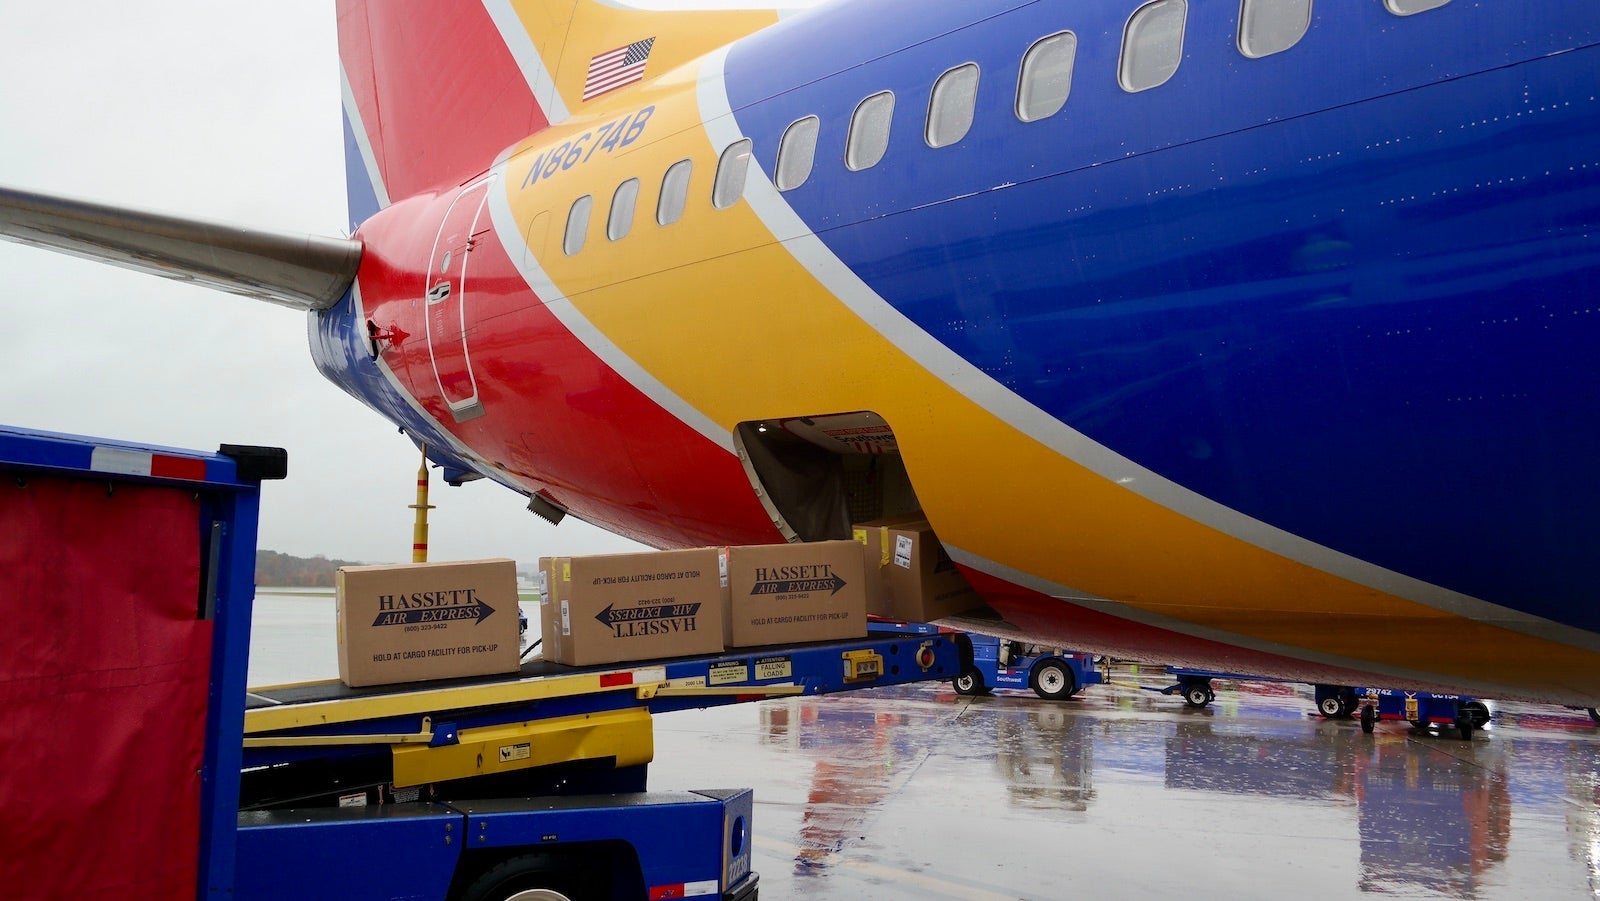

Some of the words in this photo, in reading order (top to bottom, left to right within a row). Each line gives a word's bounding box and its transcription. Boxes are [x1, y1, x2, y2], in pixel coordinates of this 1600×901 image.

[521, 105, 656, 190] N8674B
[630, 573, 656, 583] FACILITY
[656, 572, 674, 580] CARGO
[675, 571, 683, 579] AT
[683, 570, 700, 579] HOLD
[755, 564, 832, 582] HASSETT
[592, 576, 617, 585] PICK-UP
[617, 576, 630, 584] FOR
[758, 583, 778, 593] AIR
[788, 579, 836, 592] EXPRESS
[379, 588, 476, 611] HASSETT
[608, 605, 661, 621] EXPRESS
[672, 603, 693, 615] AIR
[381, 612, 407, 625] AIR
[420, 606, 481, 622] EXPRESS
[751, 618, 766, 626] HOLD
[766, 617, 774, 625] AT
[774, 616, 792, 624] CARGO
[793, 614, 816, 623] FACILITY
[816, 613, 828, 621] FOR
[828, 612, 849, 620] PICK-UP
[613, 617, 696, 638] HASSETT
[373, 654, 392, 662] HOLD
[393, 652, 402, 660] AT
[403, 650, 426, 660] CARGO
[427, 647, 455, 658] FACILITY
[457, 646, 471, 655] FOR
[471, 643, 498, 653] PICK-UP
[761, 662, 786, 671] FALLING
[763, 670, 784, 678] LOADS
[1365, 687, 1392, 696] 29742
